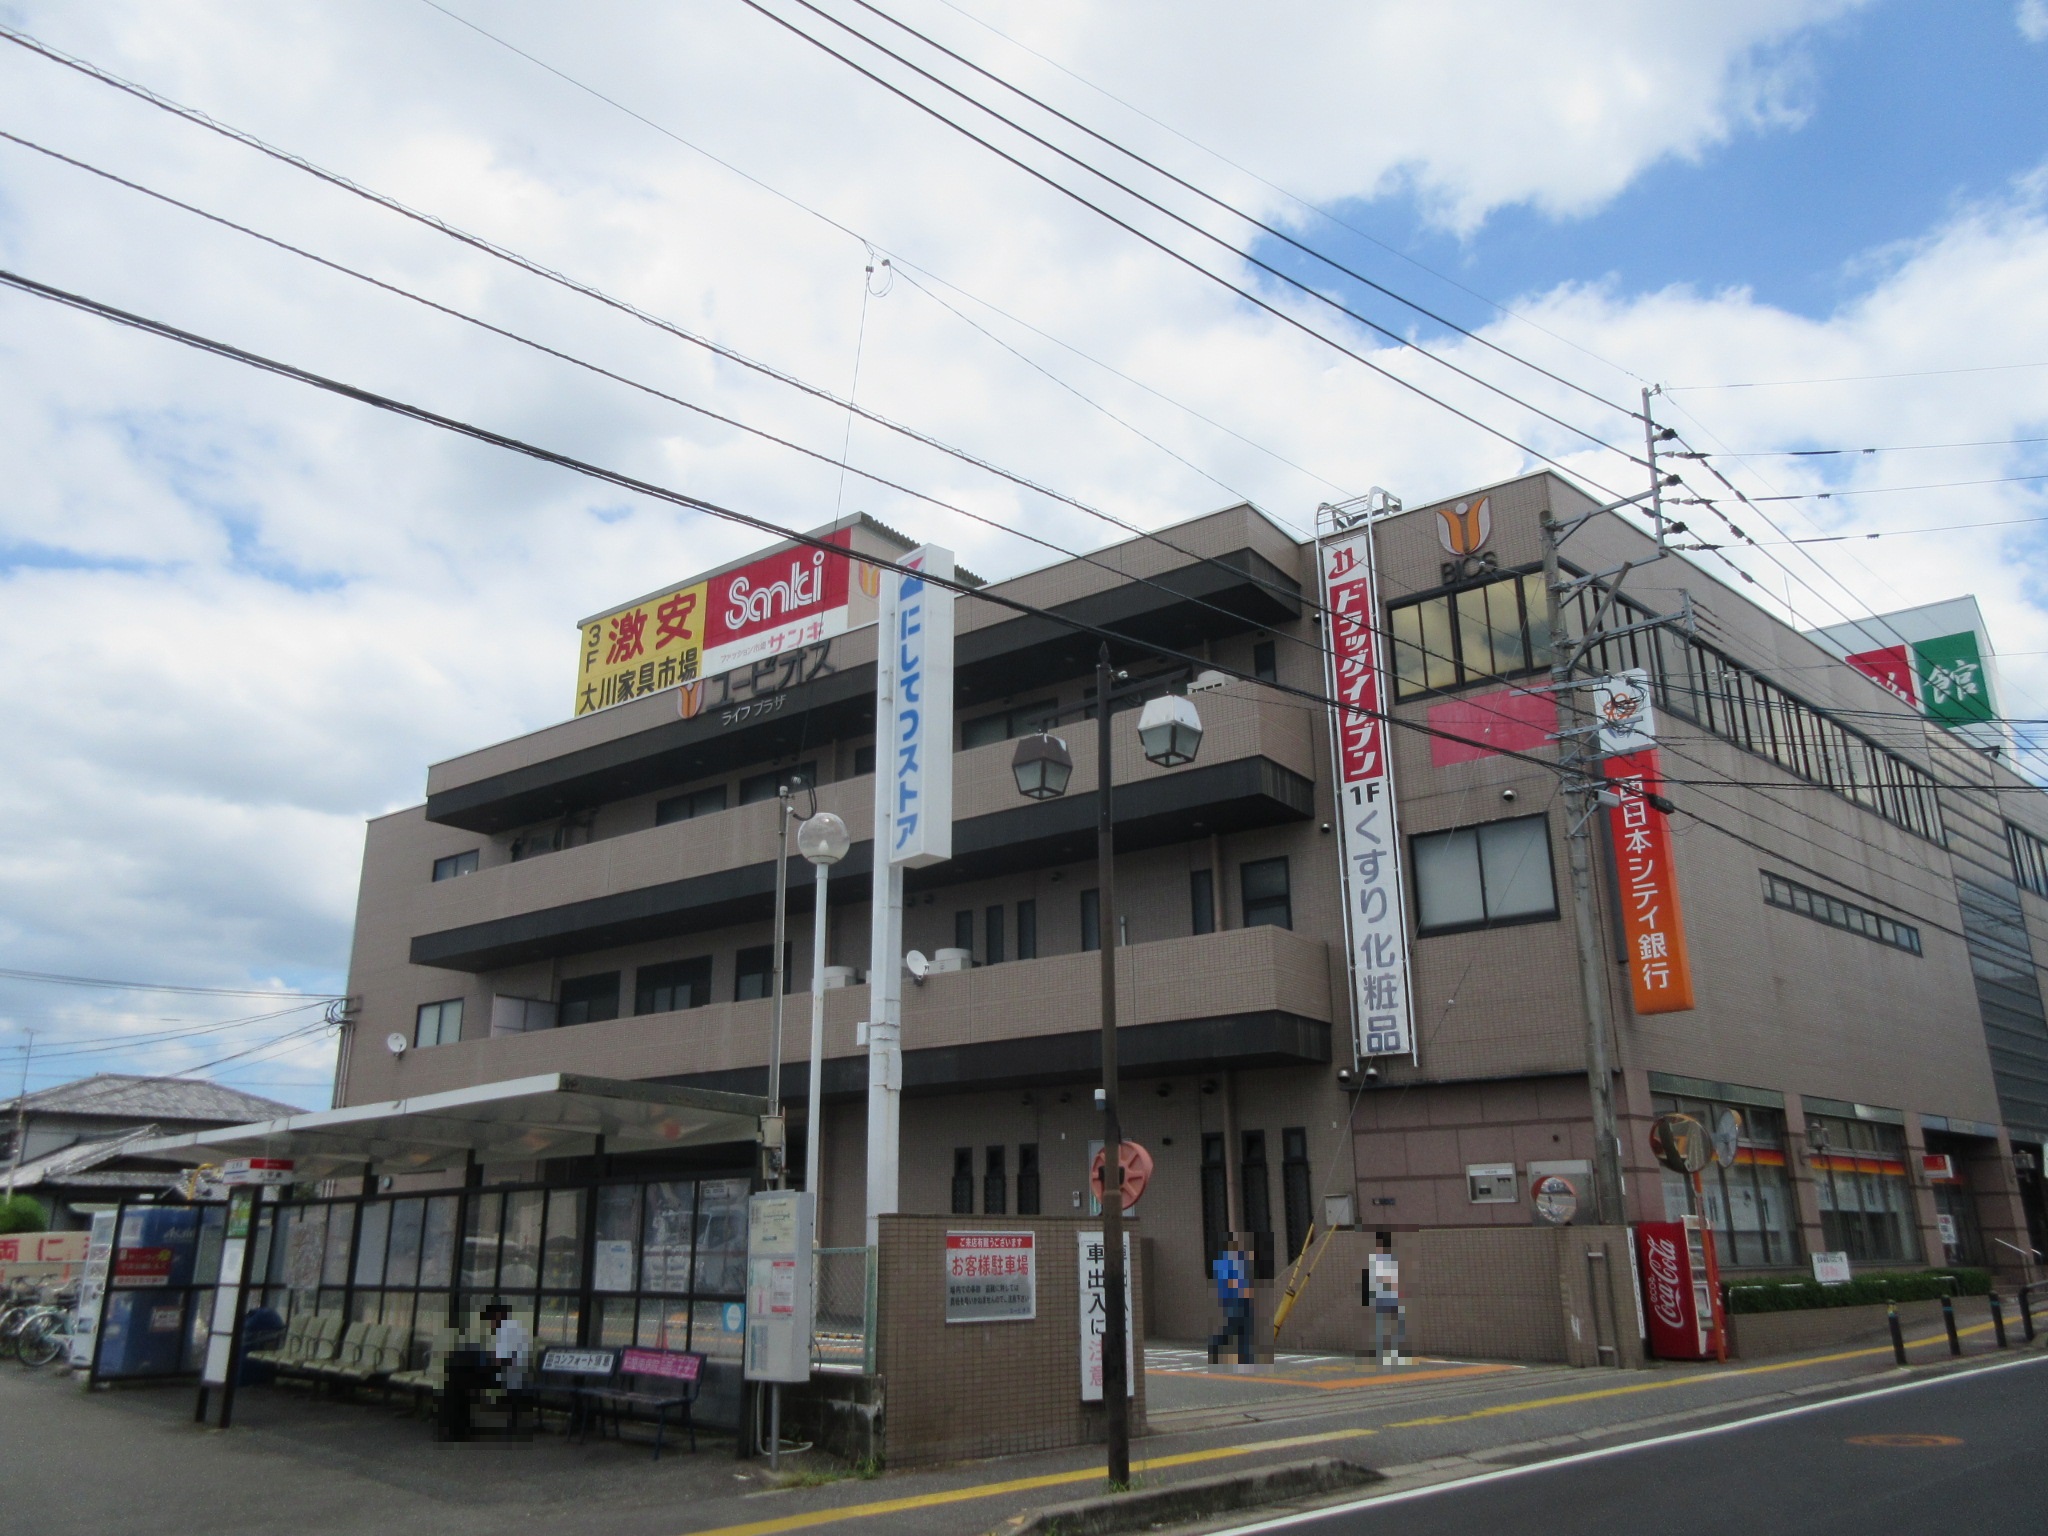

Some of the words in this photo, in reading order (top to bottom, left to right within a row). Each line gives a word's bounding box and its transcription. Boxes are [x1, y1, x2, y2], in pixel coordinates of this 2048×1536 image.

[725, 551, 825, 630] Sanki
[605, 592, 697, 665] 激安
[769, 621, 825, 654] サンキ
[579, 647, 698, 716] 大川家具市場
[705, 638, 836, 713] ユービオス
[1336, 583, 1377, 776] ドラッグイレブン
[896, 605, 921, 850] にしてつストア
[1350, 782, 1381, 805] 1F
[1617, 773, 1670, 991] 西日本シティ銀行
[952, 1254, 1029, 1277] お客様駐車場
[1647, 1233, 1685, 1328] Coca-Cola
